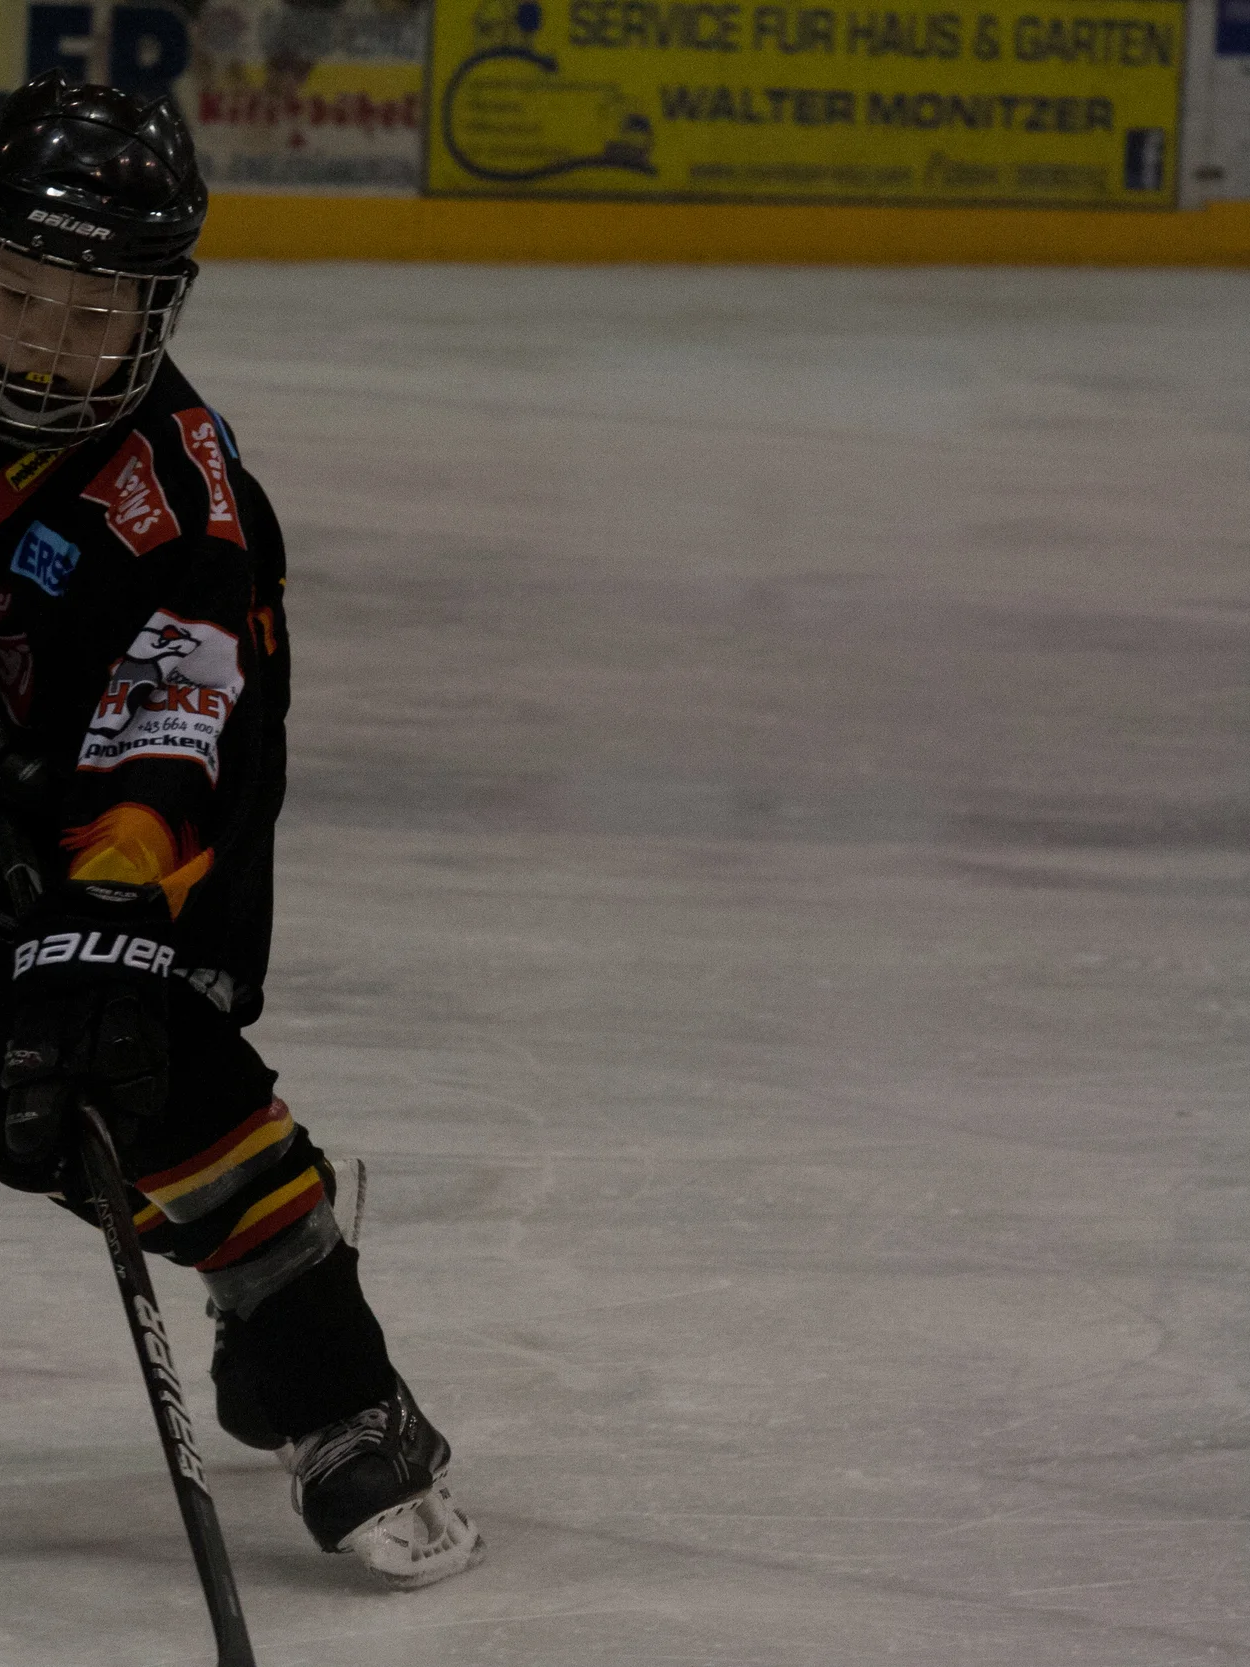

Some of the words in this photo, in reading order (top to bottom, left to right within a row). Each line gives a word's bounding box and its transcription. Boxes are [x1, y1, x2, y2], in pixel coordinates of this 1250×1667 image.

[569, 0, 742, 51] SERVICE
[846, 11, 961, 60] HAUS
[1014, 15, 1172, 67] GARTEN
[659, 84, 856, 126] WALTER
